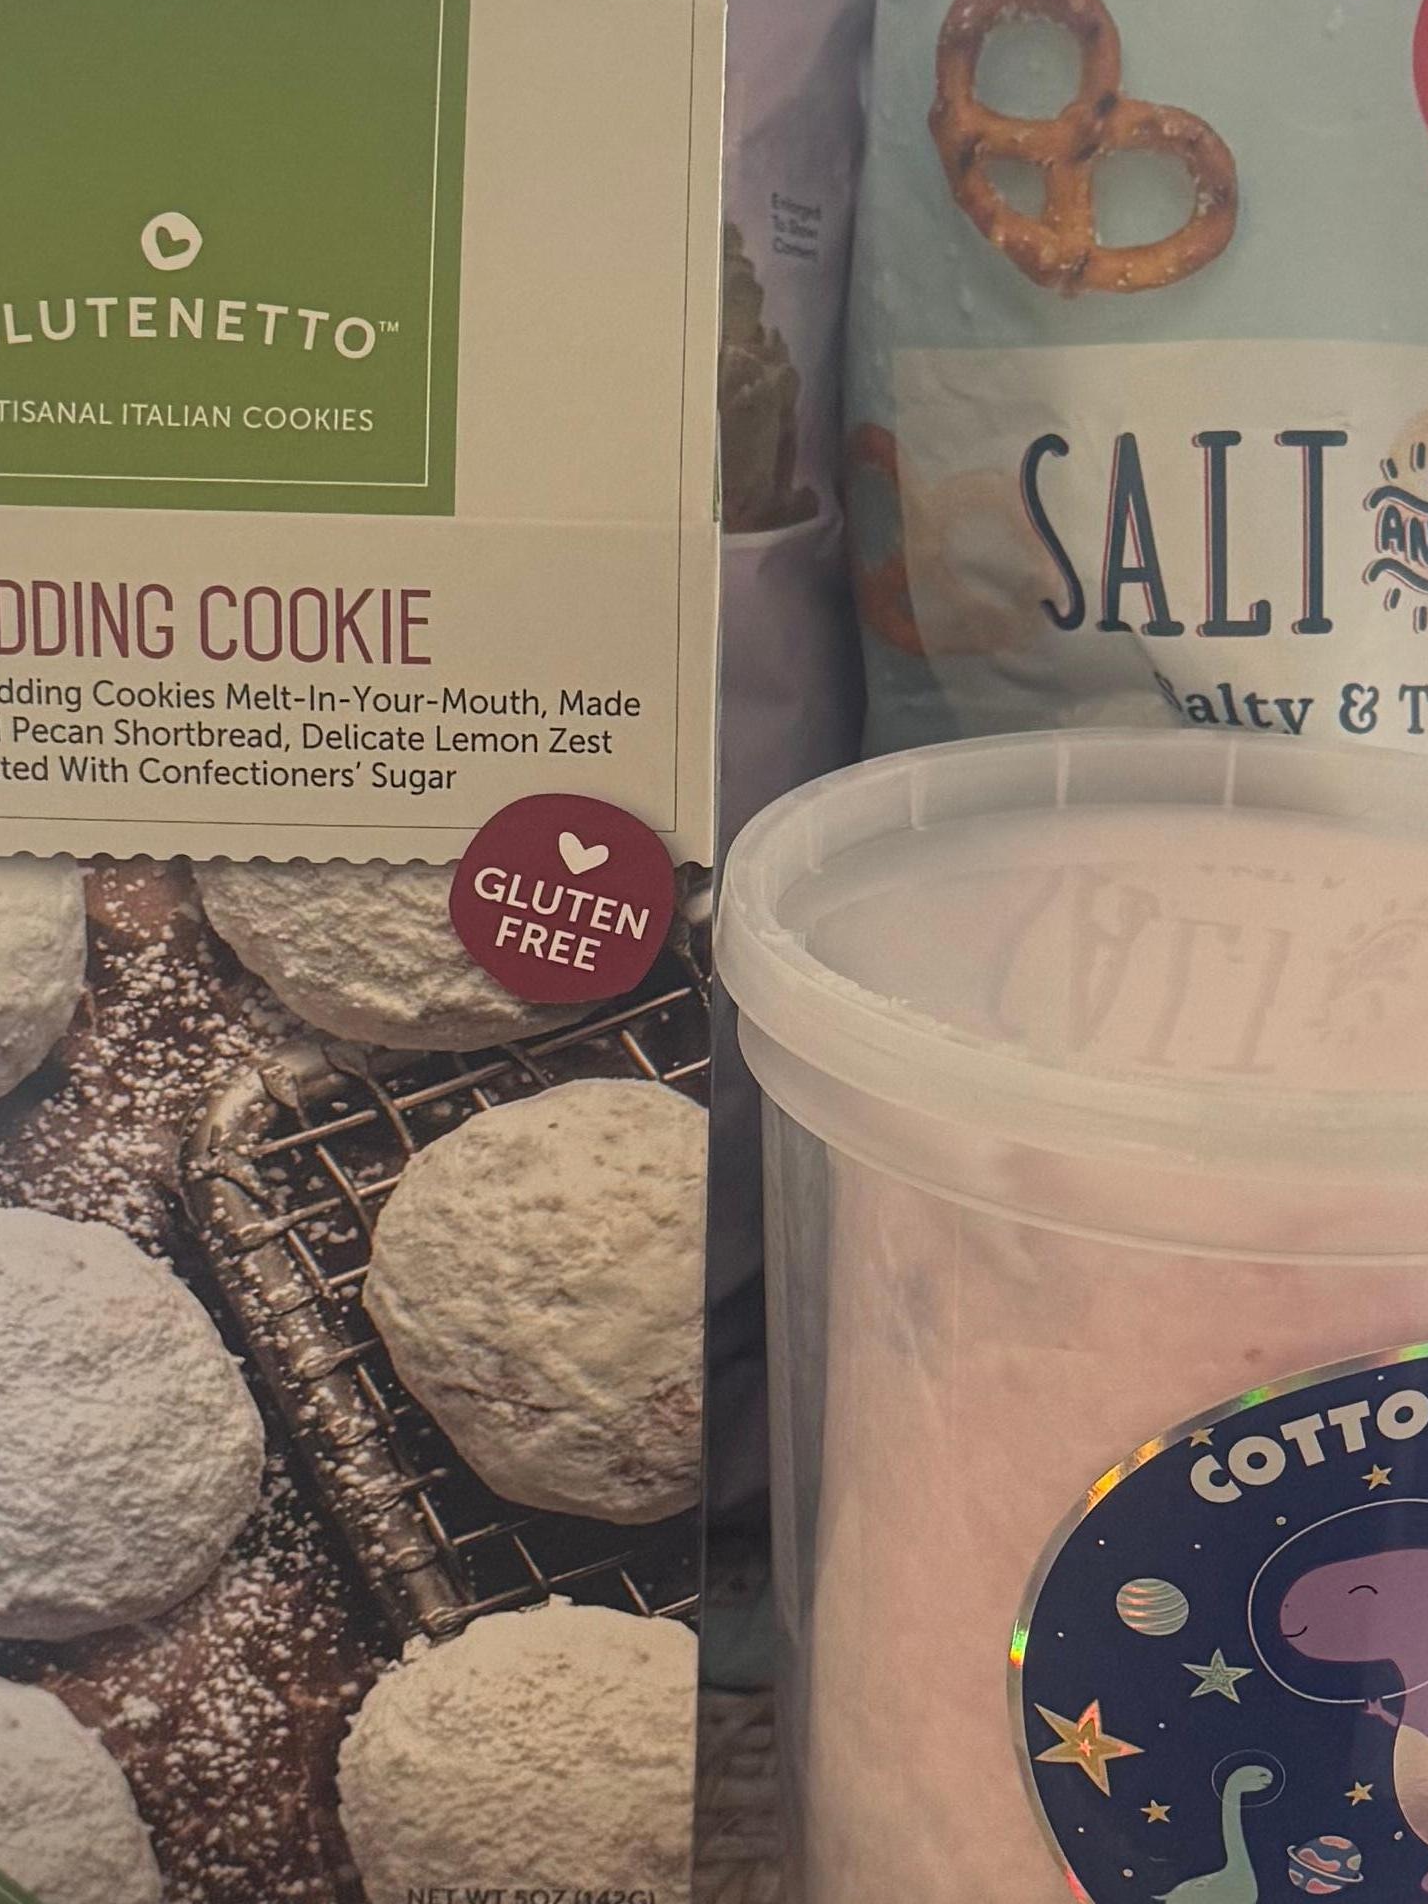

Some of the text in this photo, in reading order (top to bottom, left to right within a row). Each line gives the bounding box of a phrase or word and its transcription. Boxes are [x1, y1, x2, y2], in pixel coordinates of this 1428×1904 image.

[122, 403, 231, 428] ITALIAN
[243, 406, 374, 431] COOKIES
[1019, 430, 1348, 638] SALT
[199, 584, 432, 665] COOKIE
[93, 679, 215, 710] Cookies
[226, 683, 548, 720] Melt-In-Your-Mouth,
[559, 688, 641, 717] Made
[1338, 682, 1380, 734] &
[13, 717, 104, 745] Pecan
[114, 718, 291, 753] Shortbread,
[302, 723, 424, 752] Delicate
[436, 725, 539, 753] Lemon
[549, 727, 613, 755] Zest
[58, 755, 129, 784] With
[371, 762, 458, 796] Sugar
[474, 867, 650, 940] GLUTEN
[494, 915, 601, 972] FREE
